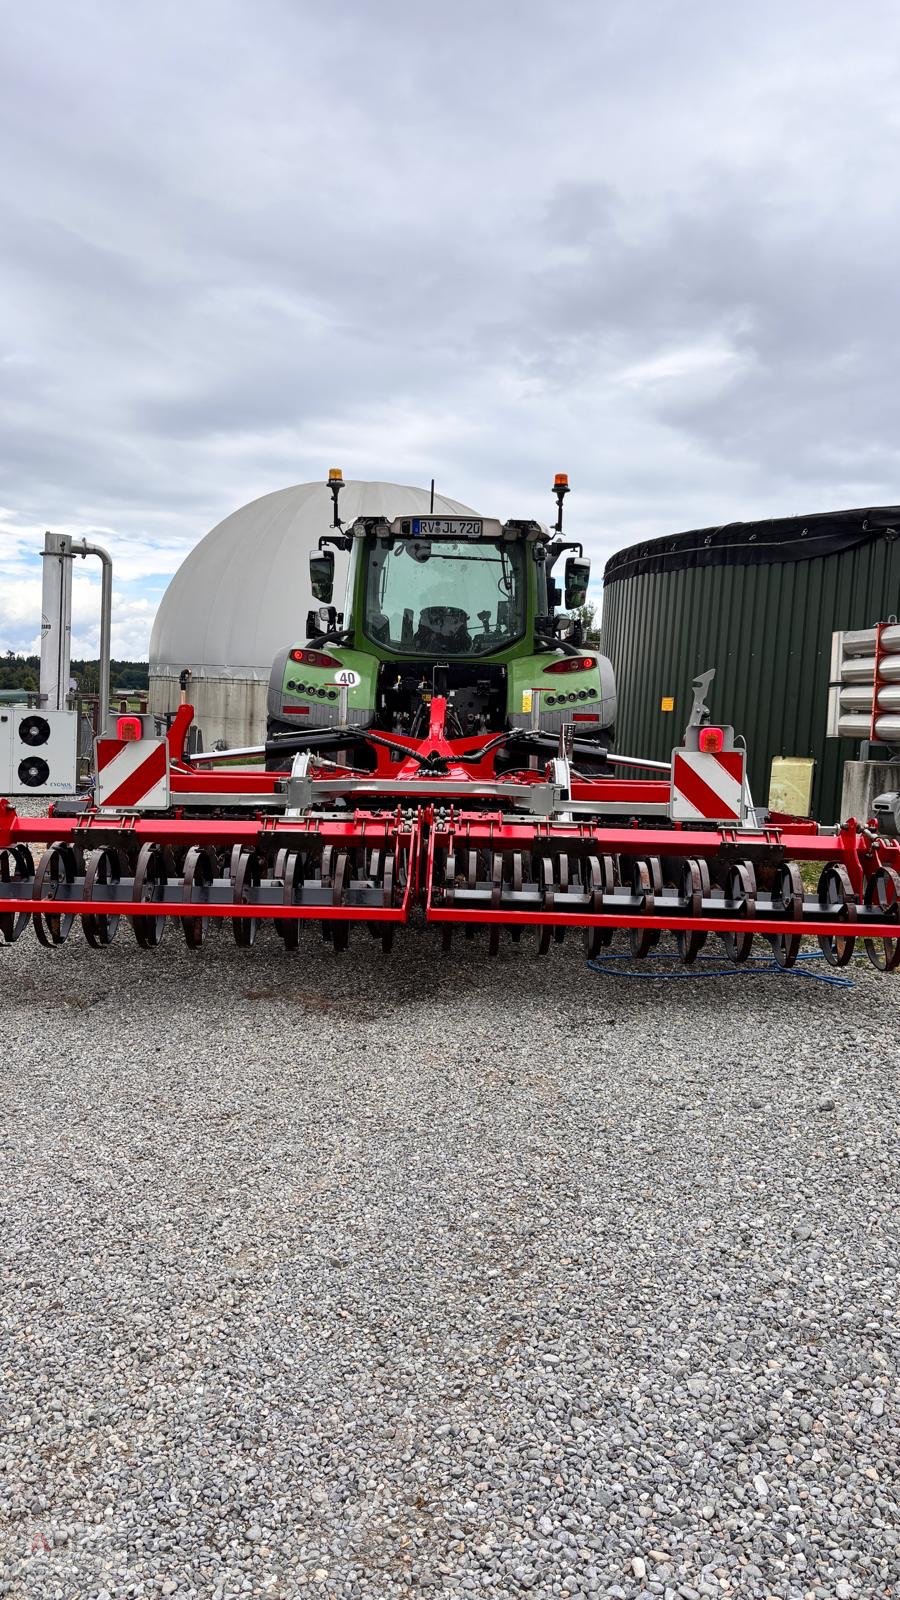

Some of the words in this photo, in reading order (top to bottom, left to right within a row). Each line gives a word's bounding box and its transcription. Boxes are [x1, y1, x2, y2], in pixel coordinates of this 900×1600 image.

[420, 521, 434, 533] RV
[442, 522, 457, 534] JL
[459, 522, 480, 534] 720
[340, 672, 355, 684] 40
